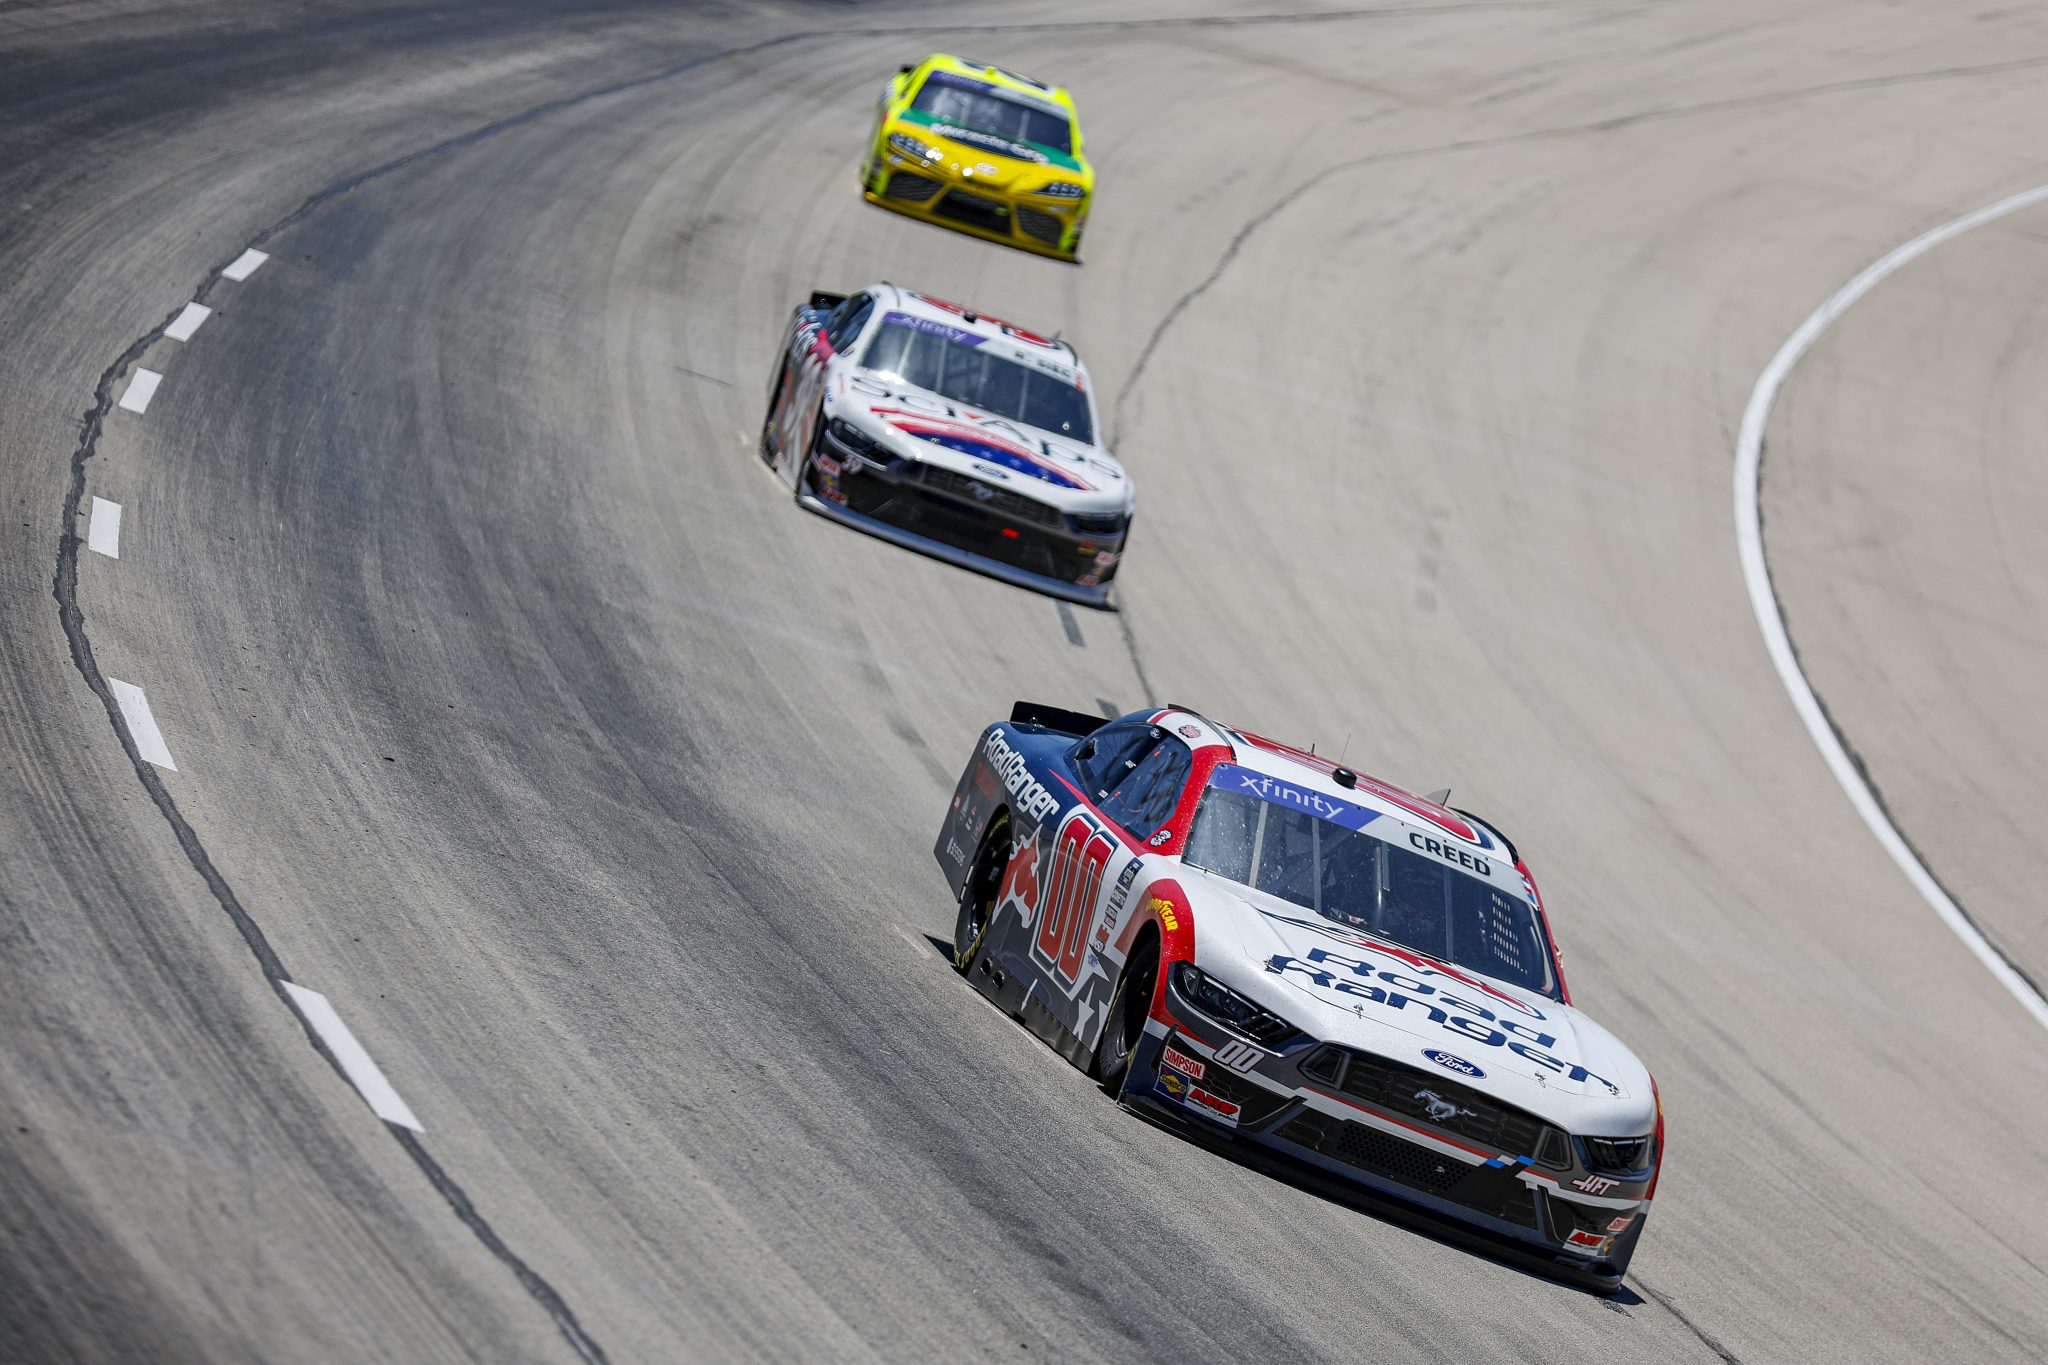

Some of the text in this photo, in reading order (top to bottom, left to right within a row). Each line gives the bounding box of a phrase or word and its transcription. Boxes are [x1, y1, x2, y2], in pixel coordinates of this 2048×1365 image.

[1240, 773, 1344, 819] xfinity
[1409, 832, 1491, 877] CREED
[1035, 813, 1117, 987] 00
[1305, 947, 1557, 1049] Road
[1266, 954, 1620, 1097] Ranger
[1165, 1048, 1203, 1078] SIMPSON
[1214, 1039, 1265, 1074] 00
[1434, 1051, 1475, 1075] Ford
[1187, 1087, 1239, 1115] ARP
